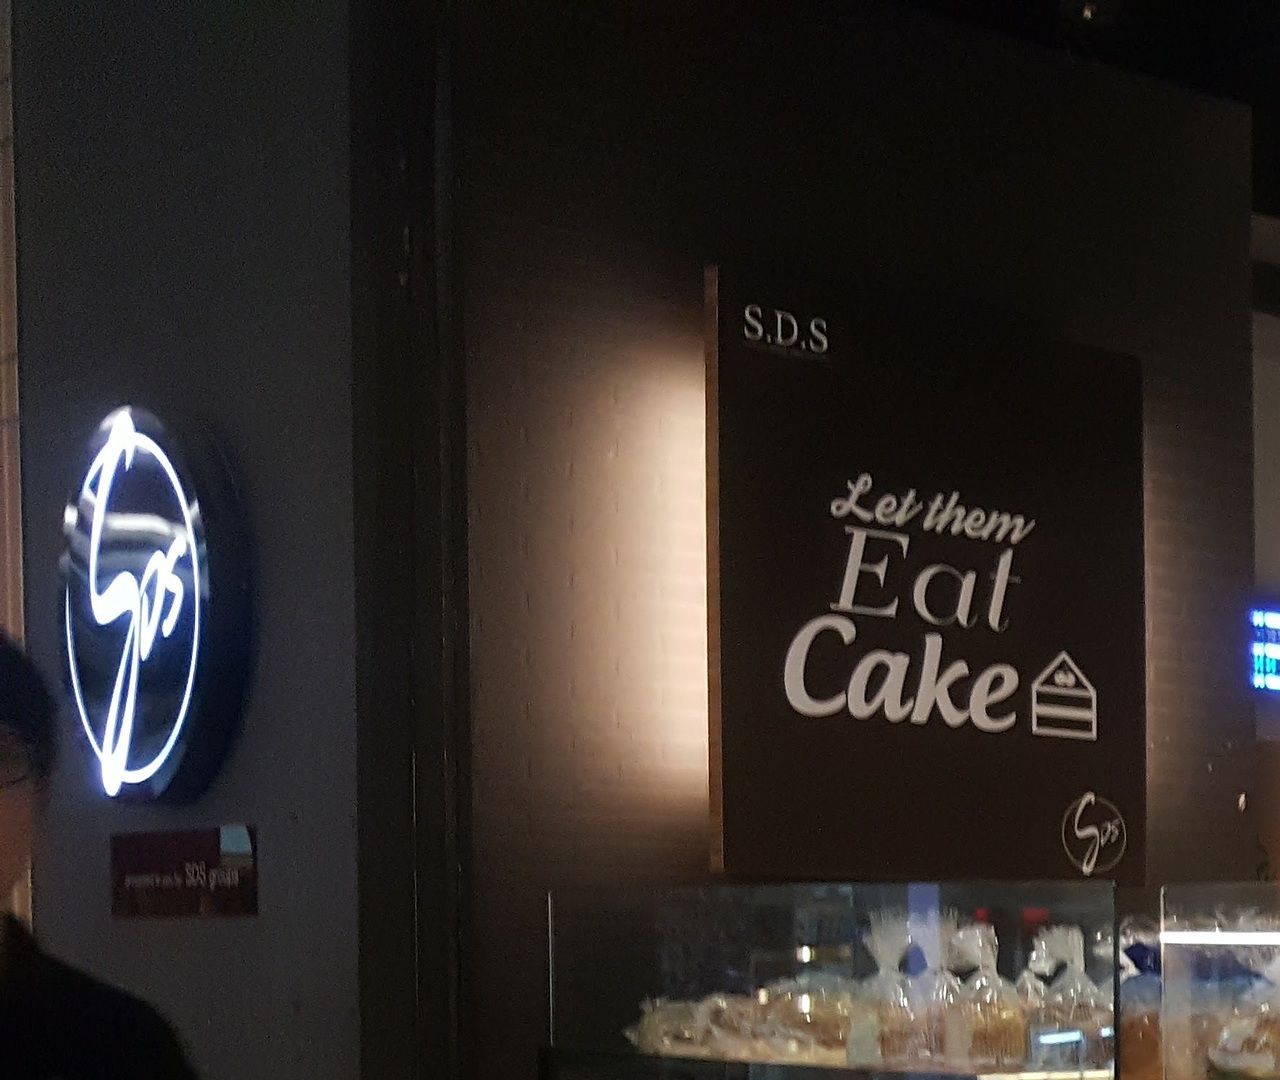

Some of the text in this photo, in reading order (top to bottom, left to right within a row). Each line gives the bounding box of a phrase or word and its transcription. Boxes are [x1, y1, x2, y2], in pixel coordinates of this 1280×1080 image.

[743, 304, 829, 354] S.D.S
[829, 472, 1036, 546] Let them
[829, 525, 1021, 633] Eat
[783, 613, 1019, 733] Cake
